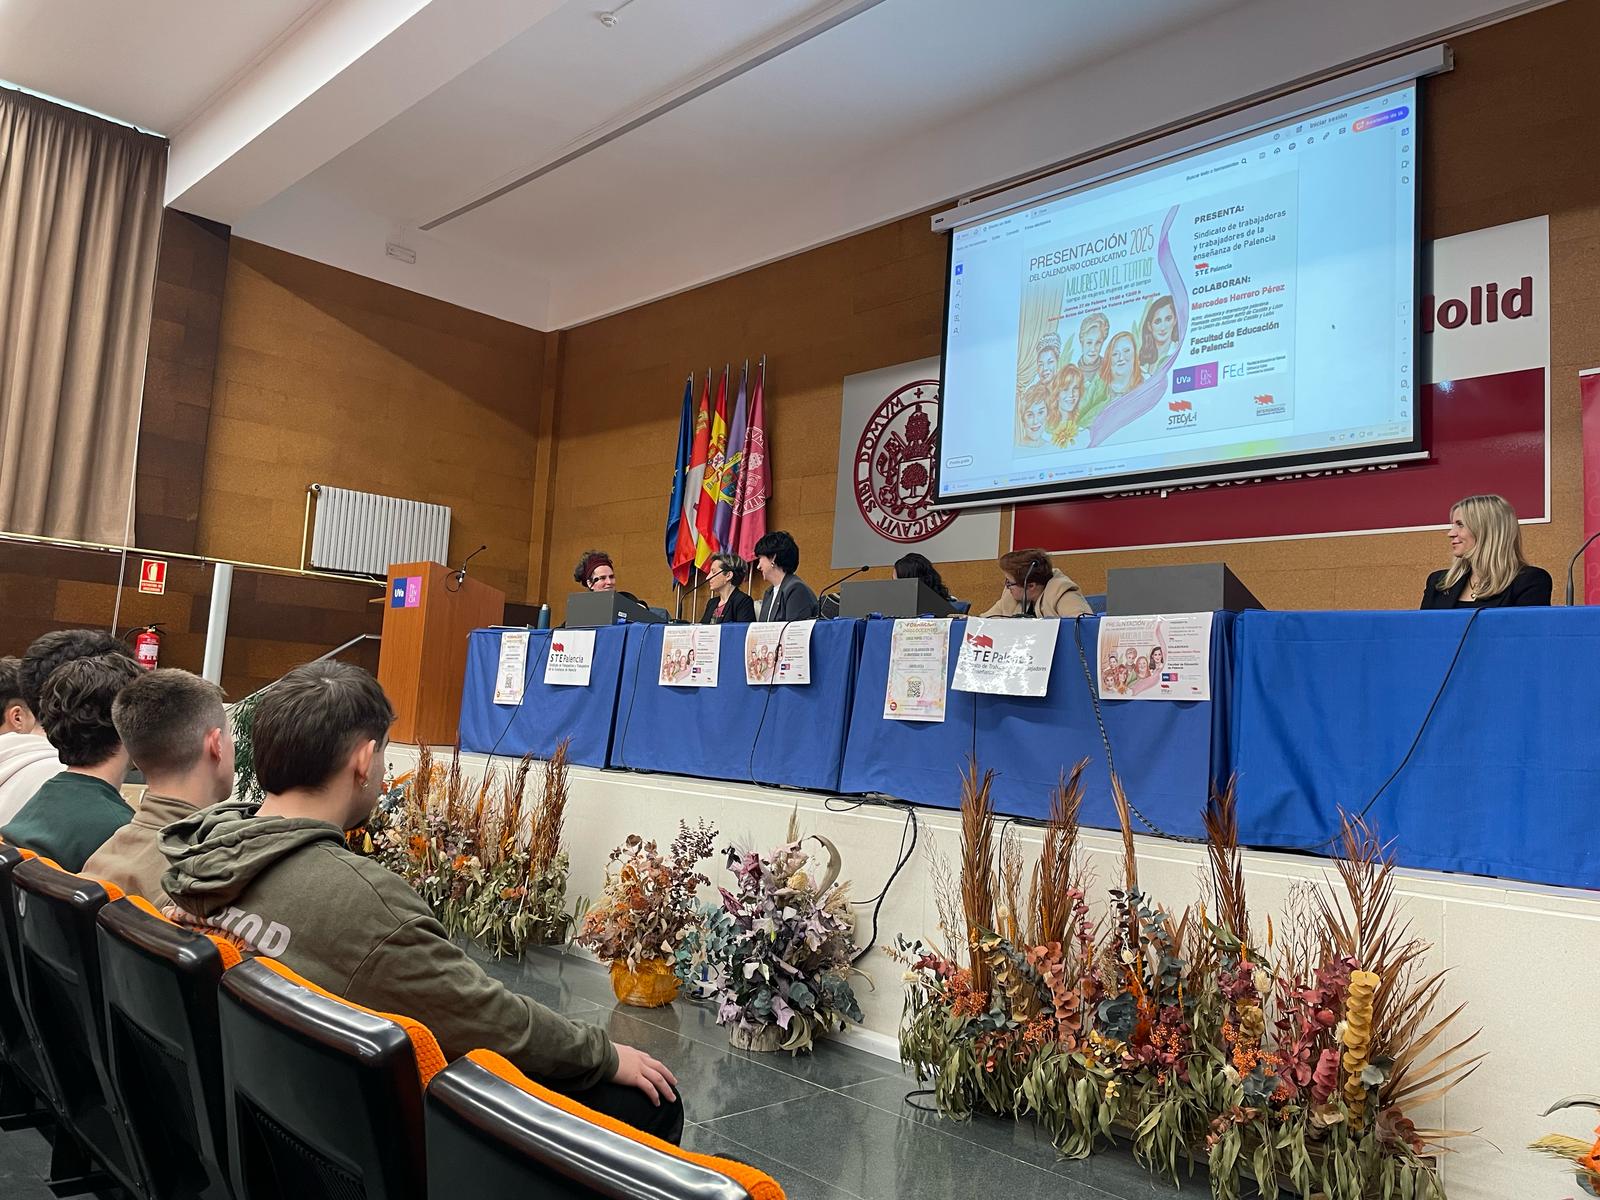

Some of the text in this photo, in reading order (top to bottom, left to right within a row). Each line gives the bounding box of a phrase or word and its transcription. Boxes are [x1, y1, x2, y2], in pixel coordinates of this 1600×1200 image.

[1193, 210, 1287, 240] Sindicato de trabajadoras
[1194, 205, 1245, 225] PRESENTA:
[1029, 224, 1154, 271] PRESENTACIÓN 2025
[1192, 234, 1276, 261] enseñanza de Palencia
[1193, 226, 1265, 253] y trabajadores de la
[1029, 250, 1127, 282] DEL CALENDARIO COEDUCATIVO
[1194, 263, 1233, 277] STE Palencia
[1065, 271, 1098, 297] MUJERES
[1099, 267, 1110, 289] EN
[1112, 265, 1121, 286] EL
[1192, 275, 1251, 296] COLABORAN:
[1191, 284, 1286, 311] Mercedes Herrero Pérez
[1190, 321, 1280, 346] Facultad de Educación
[1190, 340, 1235, 356] de Palencia
[1176, 375, 1192, 385] UVa
[1222, 362, 1245, 380] FEd
[550, 653, 584, 664] STE Palencia
